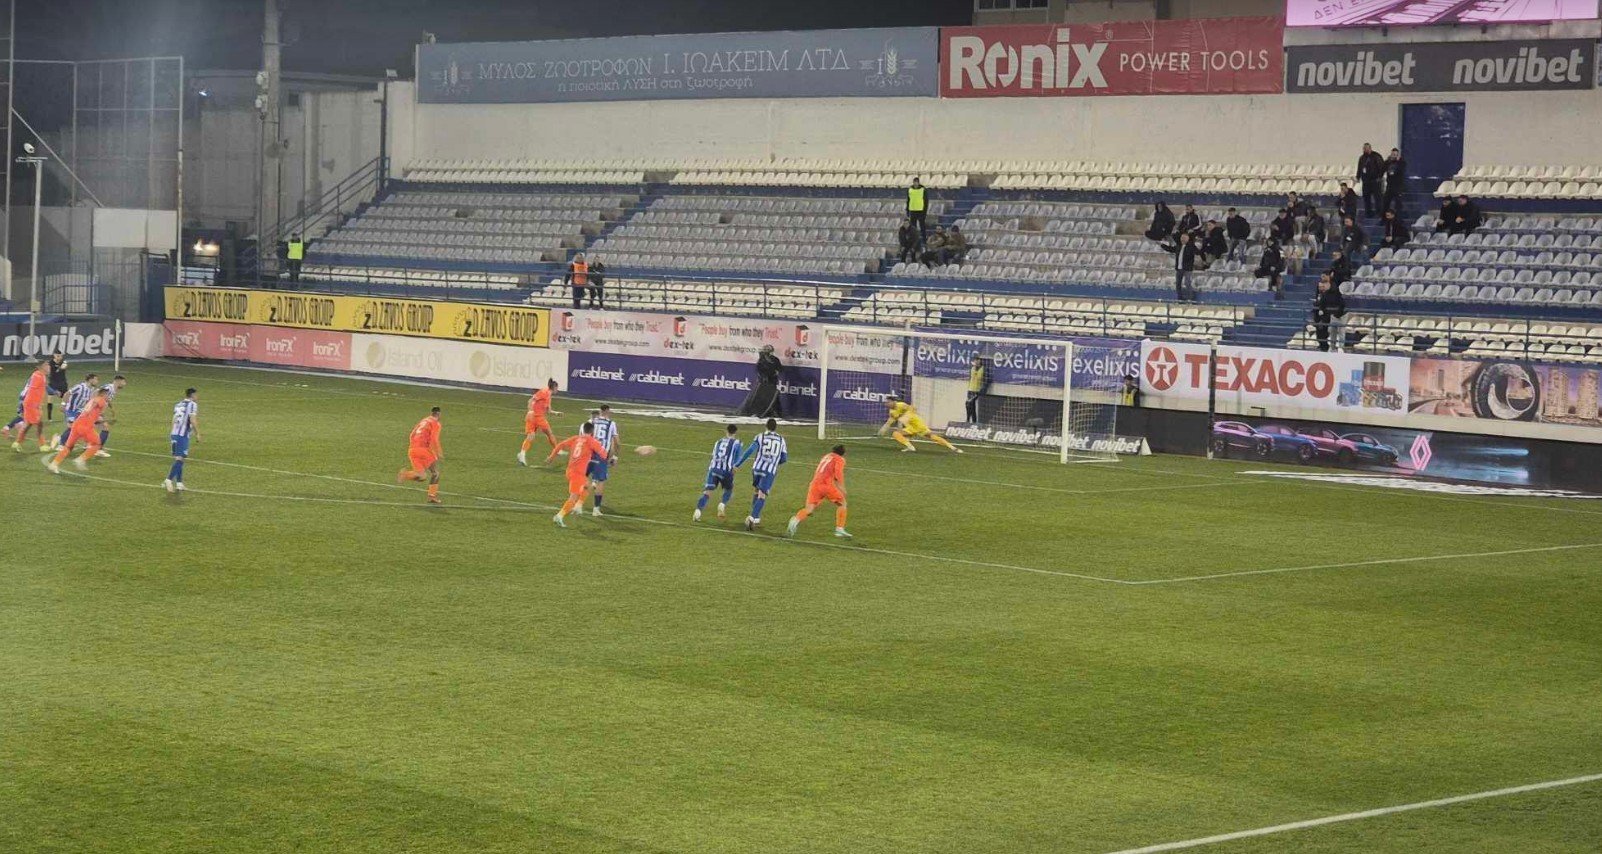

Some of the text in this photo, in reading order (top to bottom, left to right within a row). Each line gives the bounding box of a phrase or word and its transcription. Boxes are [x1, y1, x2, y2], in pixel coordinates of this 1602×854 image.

[477, 62, 537, 80] ΜΥΛΟΣ
[544, 57, 651, 78] ΖΩΟΤΡΟΦΩΝ
[682, 50, 788, 73] ΙΩΑΚΕΙΜ
[797, 48, 850, 71] ΛΤΔ
[950, 28, 1109, 90] Ronix
[1119, 49, 1269, 73] POWER TOOLS
[1297, 51, 1416, 87] novibet
[1452, 47, 1584, 85] novibet
[3, 326, 115, 356] novibet
[265, 336, 297, 353] IronFX
[312, 340, 344, 357] IronFX
[993, 349, 1059, 372] exelixis
[1072, 355, 1140, 378] exelixis
[1184, 353, 1335, 399] TEXACO
[776, 380, 817, 397] blenet
[945, 424, 992, 440] novibet
[993, 428, 1041, 444] novibet
[1041, 432, 1090, 449] novbet
[762, 438, 781, 458] 20
[1091, 436, 1141, 453] novibet
